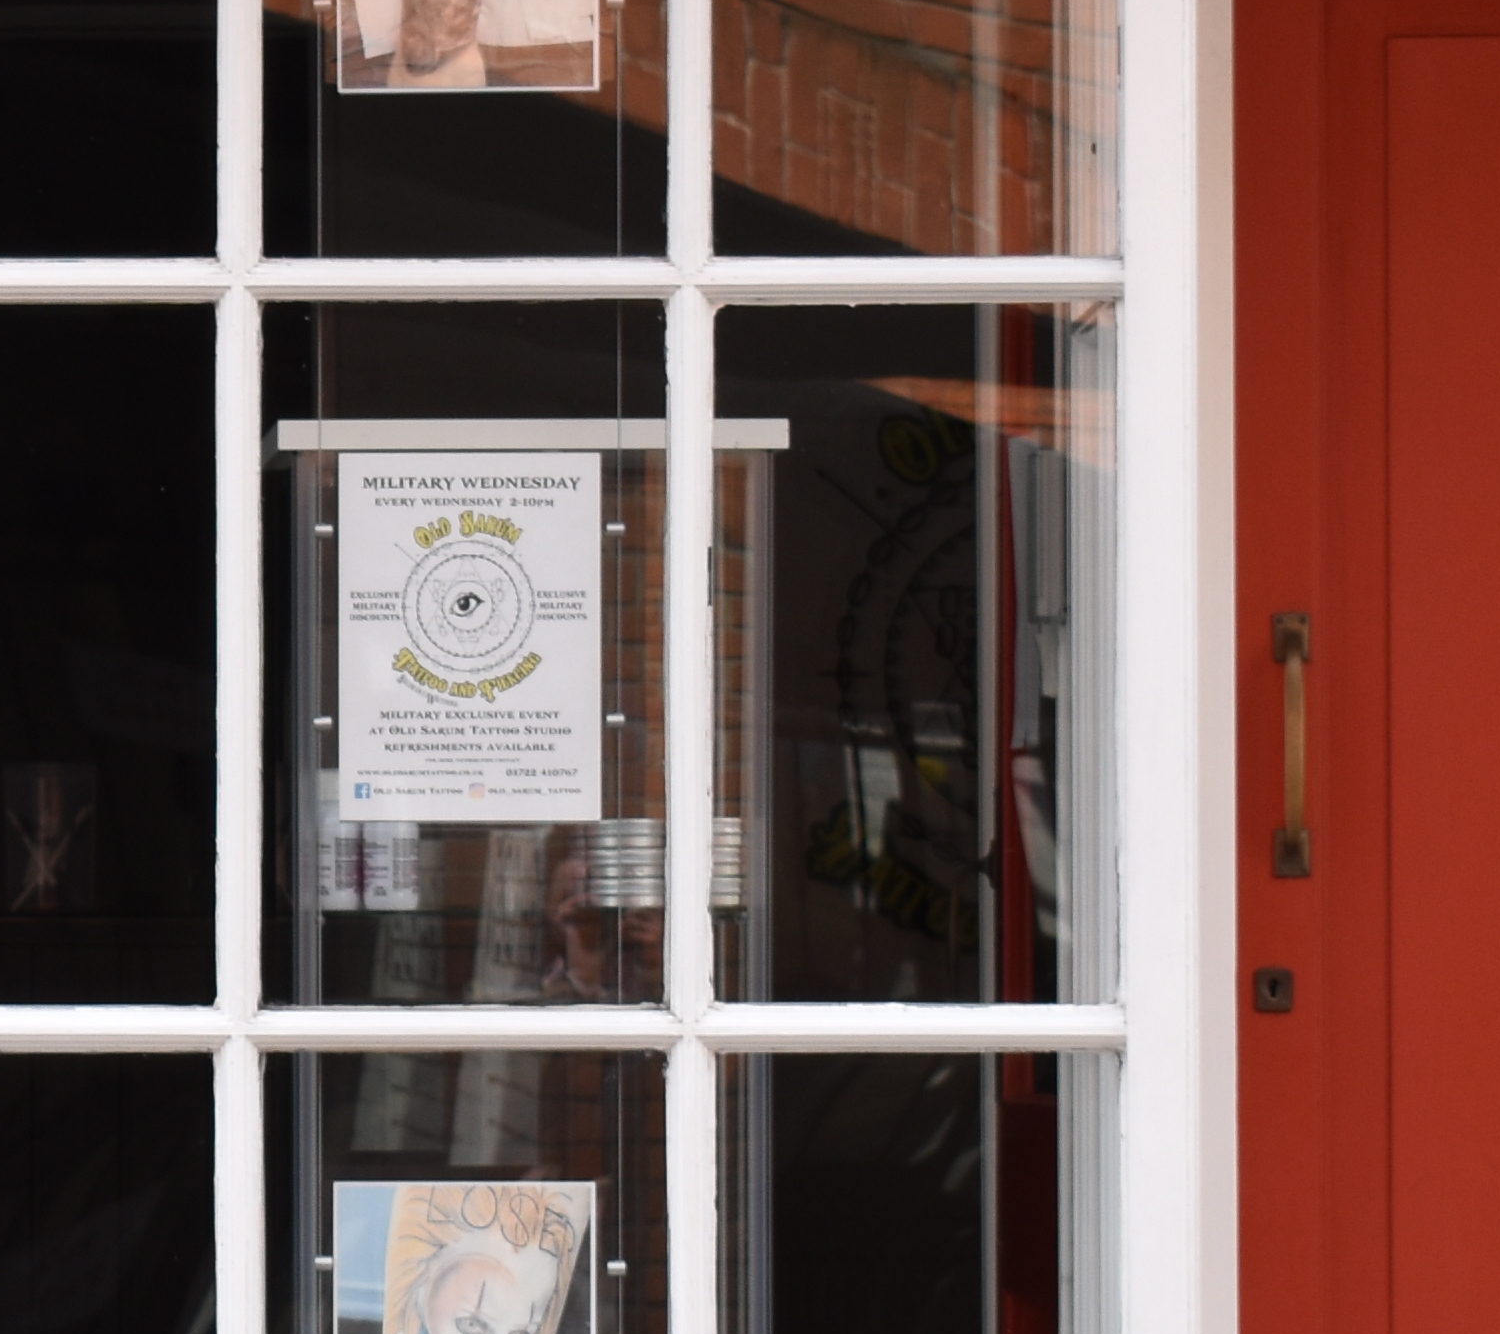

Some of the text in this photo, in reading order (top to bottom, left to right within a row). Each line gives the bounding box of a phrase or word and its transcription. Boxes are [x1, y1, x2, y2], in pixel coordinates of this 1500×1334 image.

[362, 476, 581, 491] MILITARY WEDNESDAY
[374, 497, 416, 507] EVERY
[421, 497, 504, 507] WEDNESDAY
[350, 591, 400, 600] EXCLUSIVE
[537, 590, 587, 599] EXCLUSIVE
[353, 602, 397, 611] MILITARY
[539, 601, 583, 610] MILITARY
[380, 710, 560, 720] MILITARY EXCLUSIVE EVENT
[469, 725, 520, 736] TATTOO
[384, 742, 556, 752] REFRESHMENTS AVAILABLE
[506, 768, 537, 777] 01722
